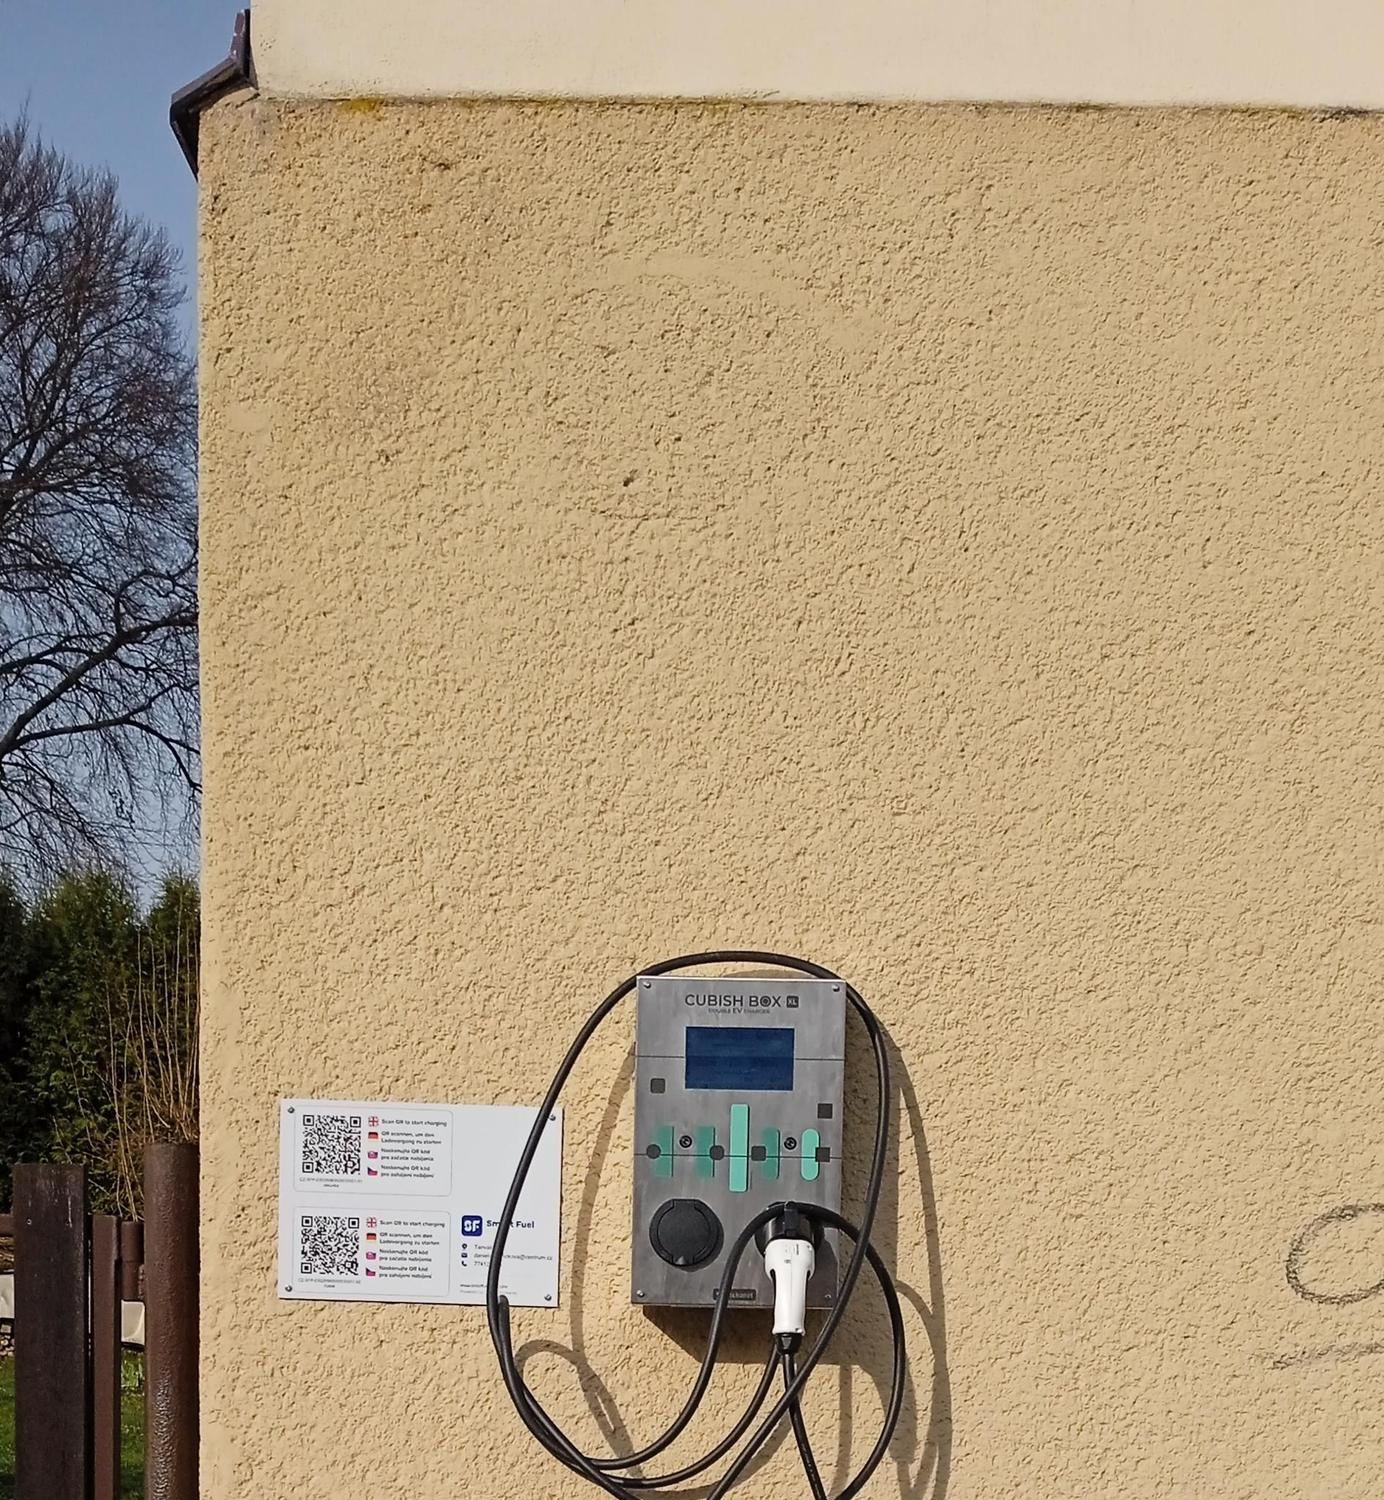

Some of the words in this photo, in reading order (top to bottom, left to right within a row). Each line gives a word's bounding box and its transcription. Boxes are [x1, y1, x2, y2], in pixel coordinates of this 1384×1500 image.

[685, 994, 743, 1007] CUBISH
[749, 995, 781, 1007] BOX
[464, 1220, 480, 1232] SF
[487, 1220, 514, 1228] Smt
[516, 1221, 535, 1229] Fuel
